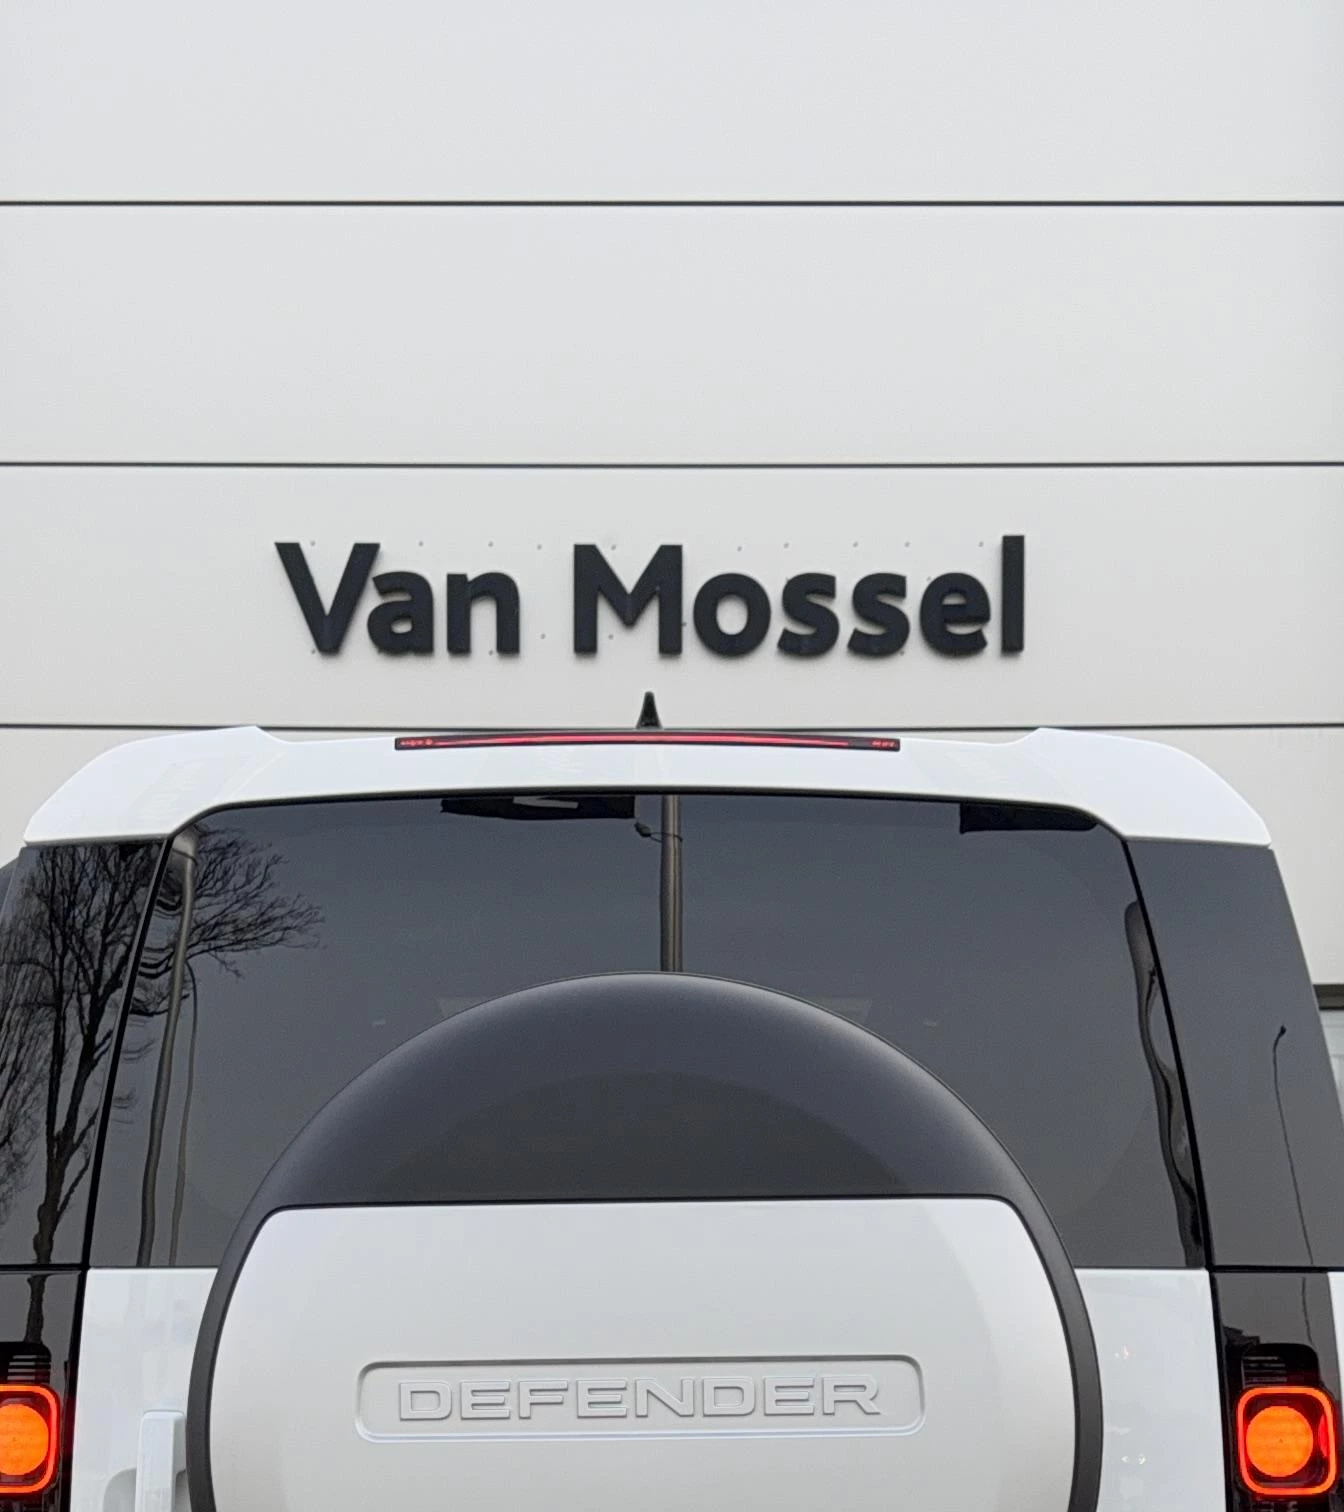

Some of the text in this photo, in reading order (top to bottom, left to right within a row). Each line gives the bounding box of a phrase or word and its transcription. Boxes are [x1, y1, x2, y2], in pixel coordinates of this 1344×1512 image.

[274, 535, 1025, 657] Van Mossel
[399, 1374, 881, 1421] DEFENDER
